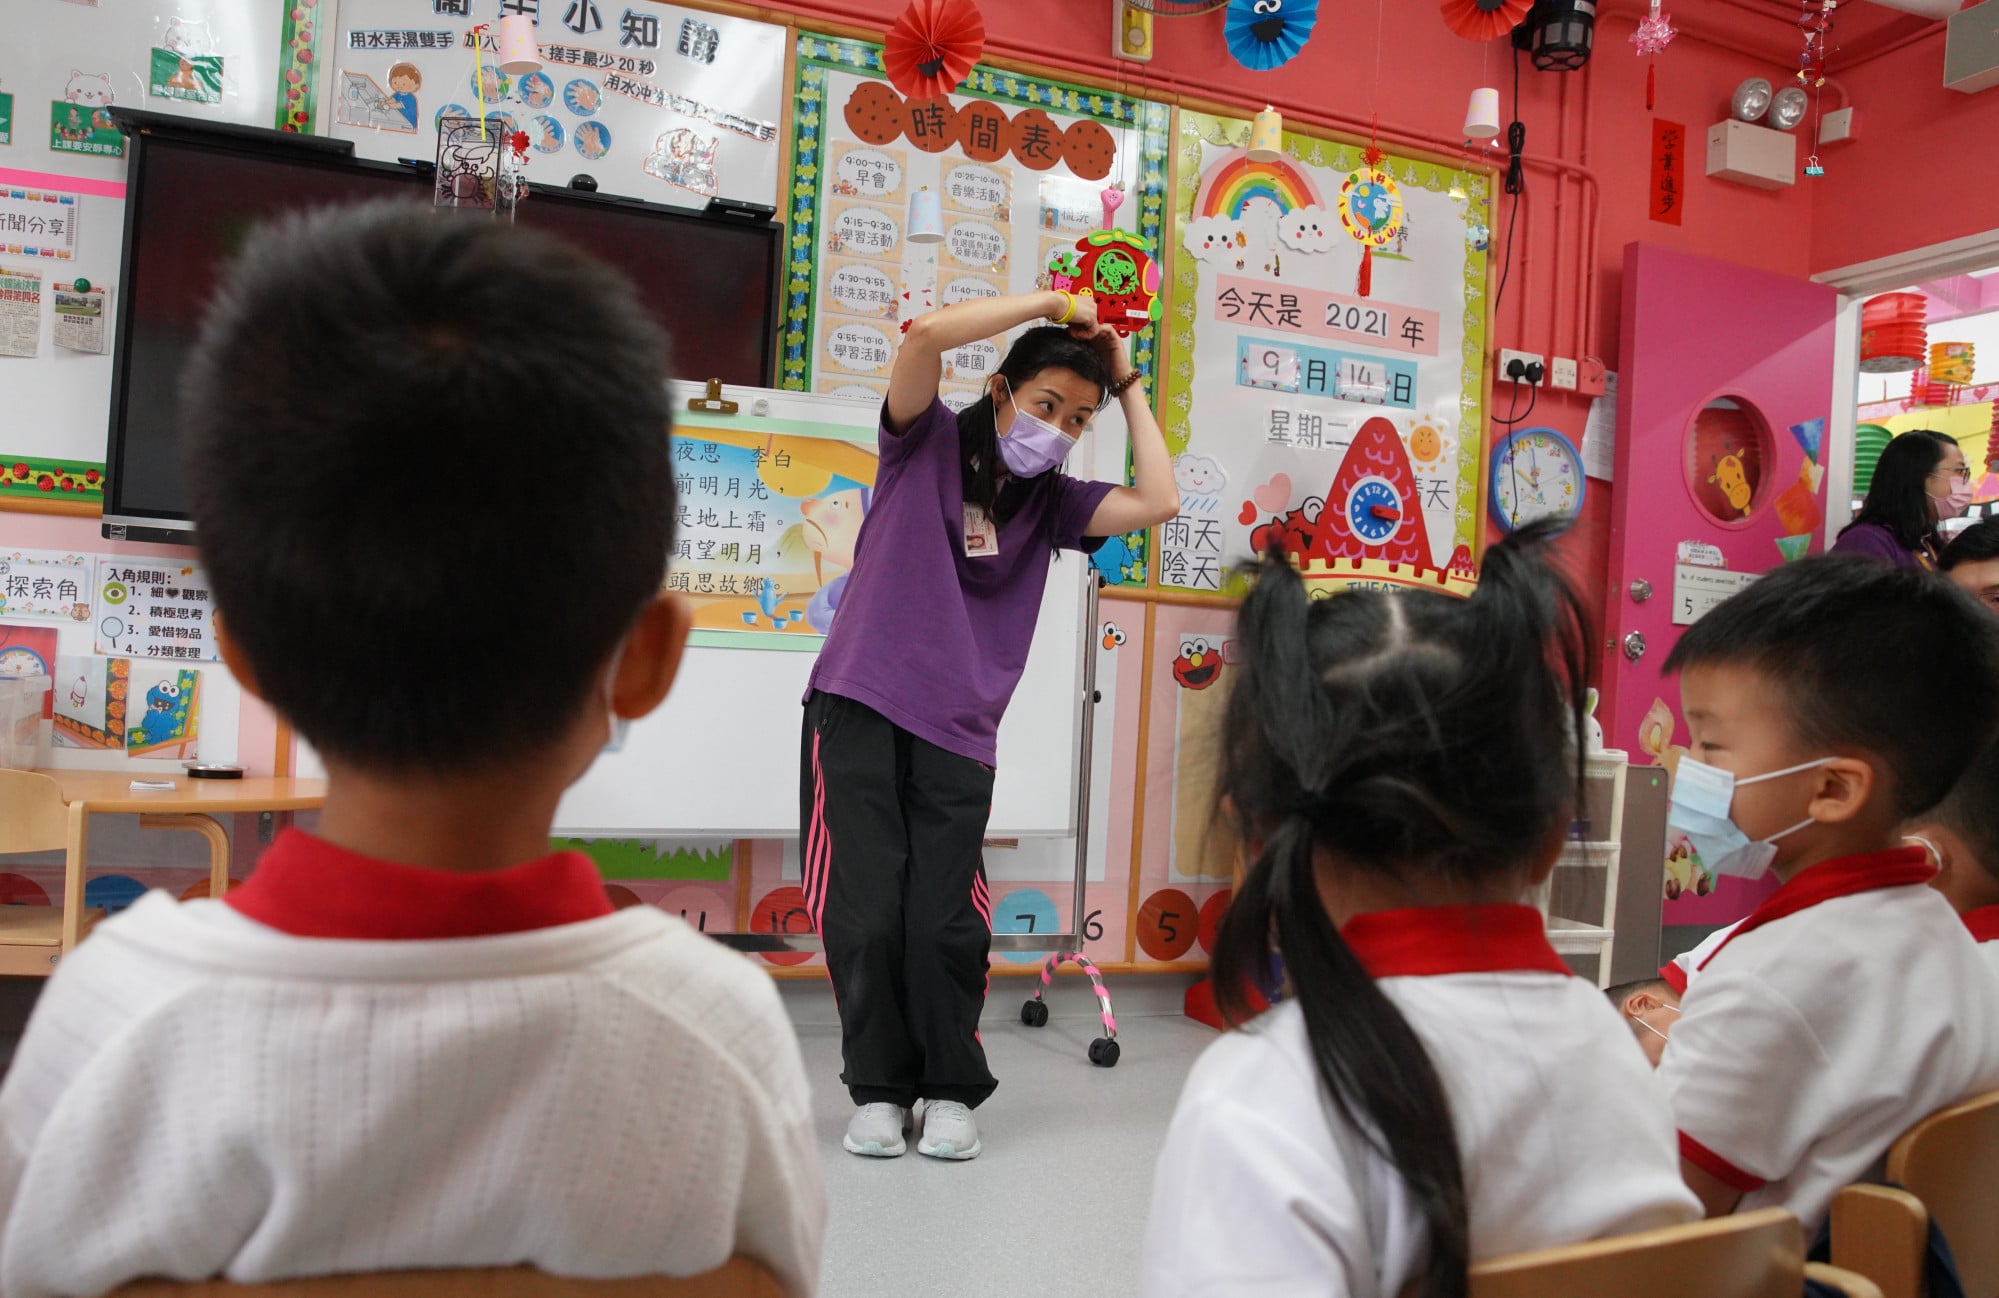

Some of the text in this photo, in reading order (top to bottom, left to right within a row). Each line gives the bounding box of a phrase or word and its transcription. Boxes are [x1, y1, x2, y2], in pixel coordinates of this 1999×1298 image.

[619, 57, 635, 72] 20
[638, 59, 655, 76] 秒
[912, 103, 1053, 162] 時間表
[855, 169, 887, 188] 早會
[952, 184, 1001, 203] 音樂活動
[841, 228, 893, 248] 學習活動
[1218, 287, 1425, 348] 今天是 2021 年
[834, 344, 887, 363] 學習活動
[955, 352, 985, 370] 離園
[1263, 351, 1413, 404] 9 月 14 日
[1268, 409, 1350, 447] 星期二
[750, 446, 791, 468] 李白
[1164, 515, 1222, 553] 雨天
[1161, 550, 1219, 590] 陰天
[5, 574, 79, 602] 探索角
[128, 605, 204, 620] 2. 積極思考
[1684, 596, 1693, 616] 5
[127, 624, 202, 640] 3. 愛惜物品
[125, 644, 201, 659] 4. 分類整理
[1083, 909, 1104, 942] 6
[1158, 910, 1181, 943] 5
